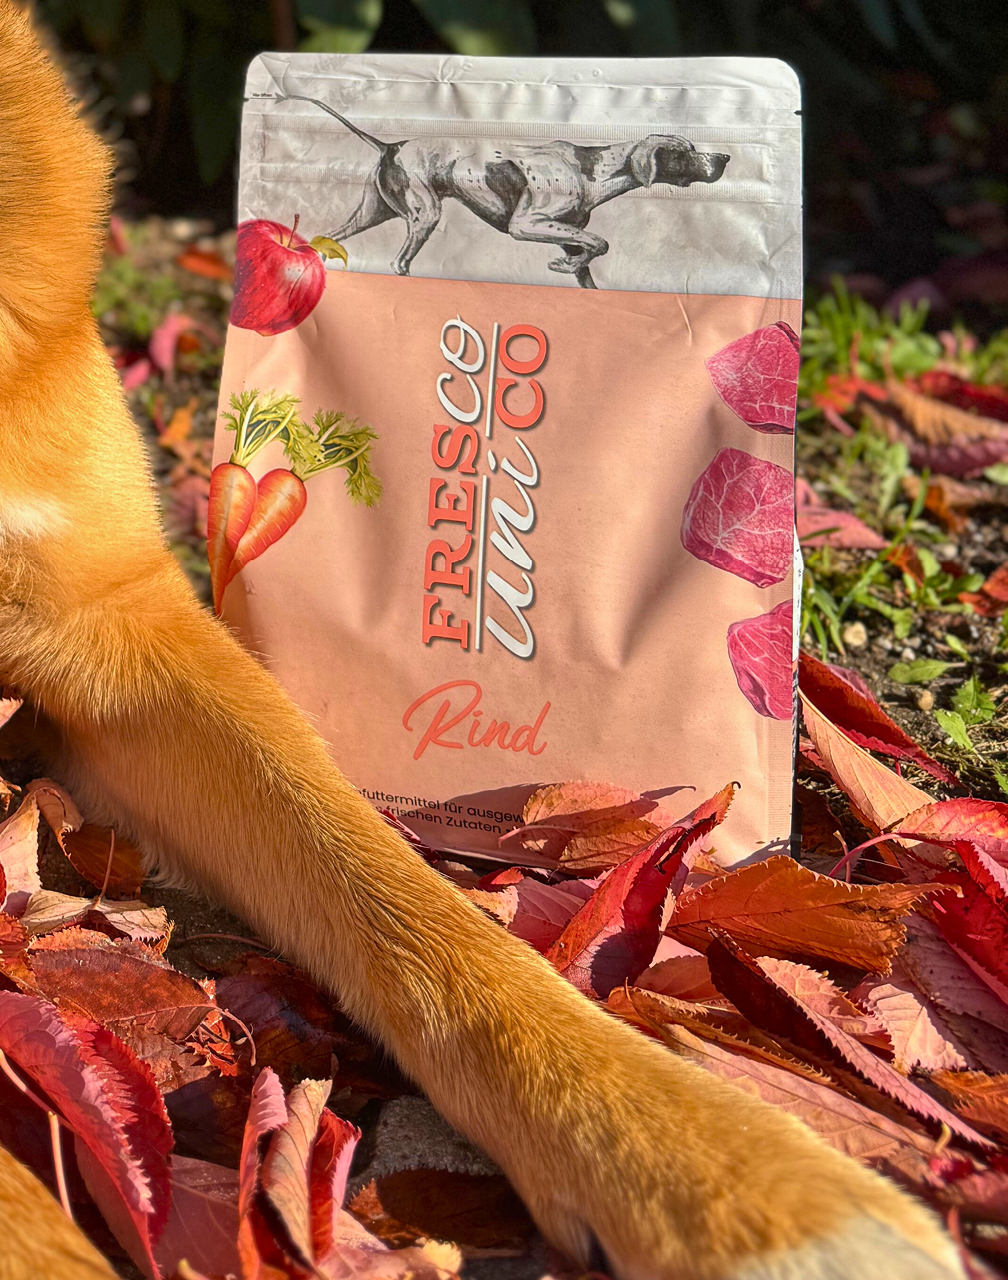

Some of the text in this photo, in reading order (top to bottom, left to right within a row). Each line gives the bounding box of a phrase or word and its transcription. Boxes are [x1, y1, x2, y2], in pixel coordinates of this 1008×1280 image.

[402, 679, 552, 760] Rind
[358, 788, 524, 823] futtermittel für ausgew
[446, 816, 502, 834] Zutaten
